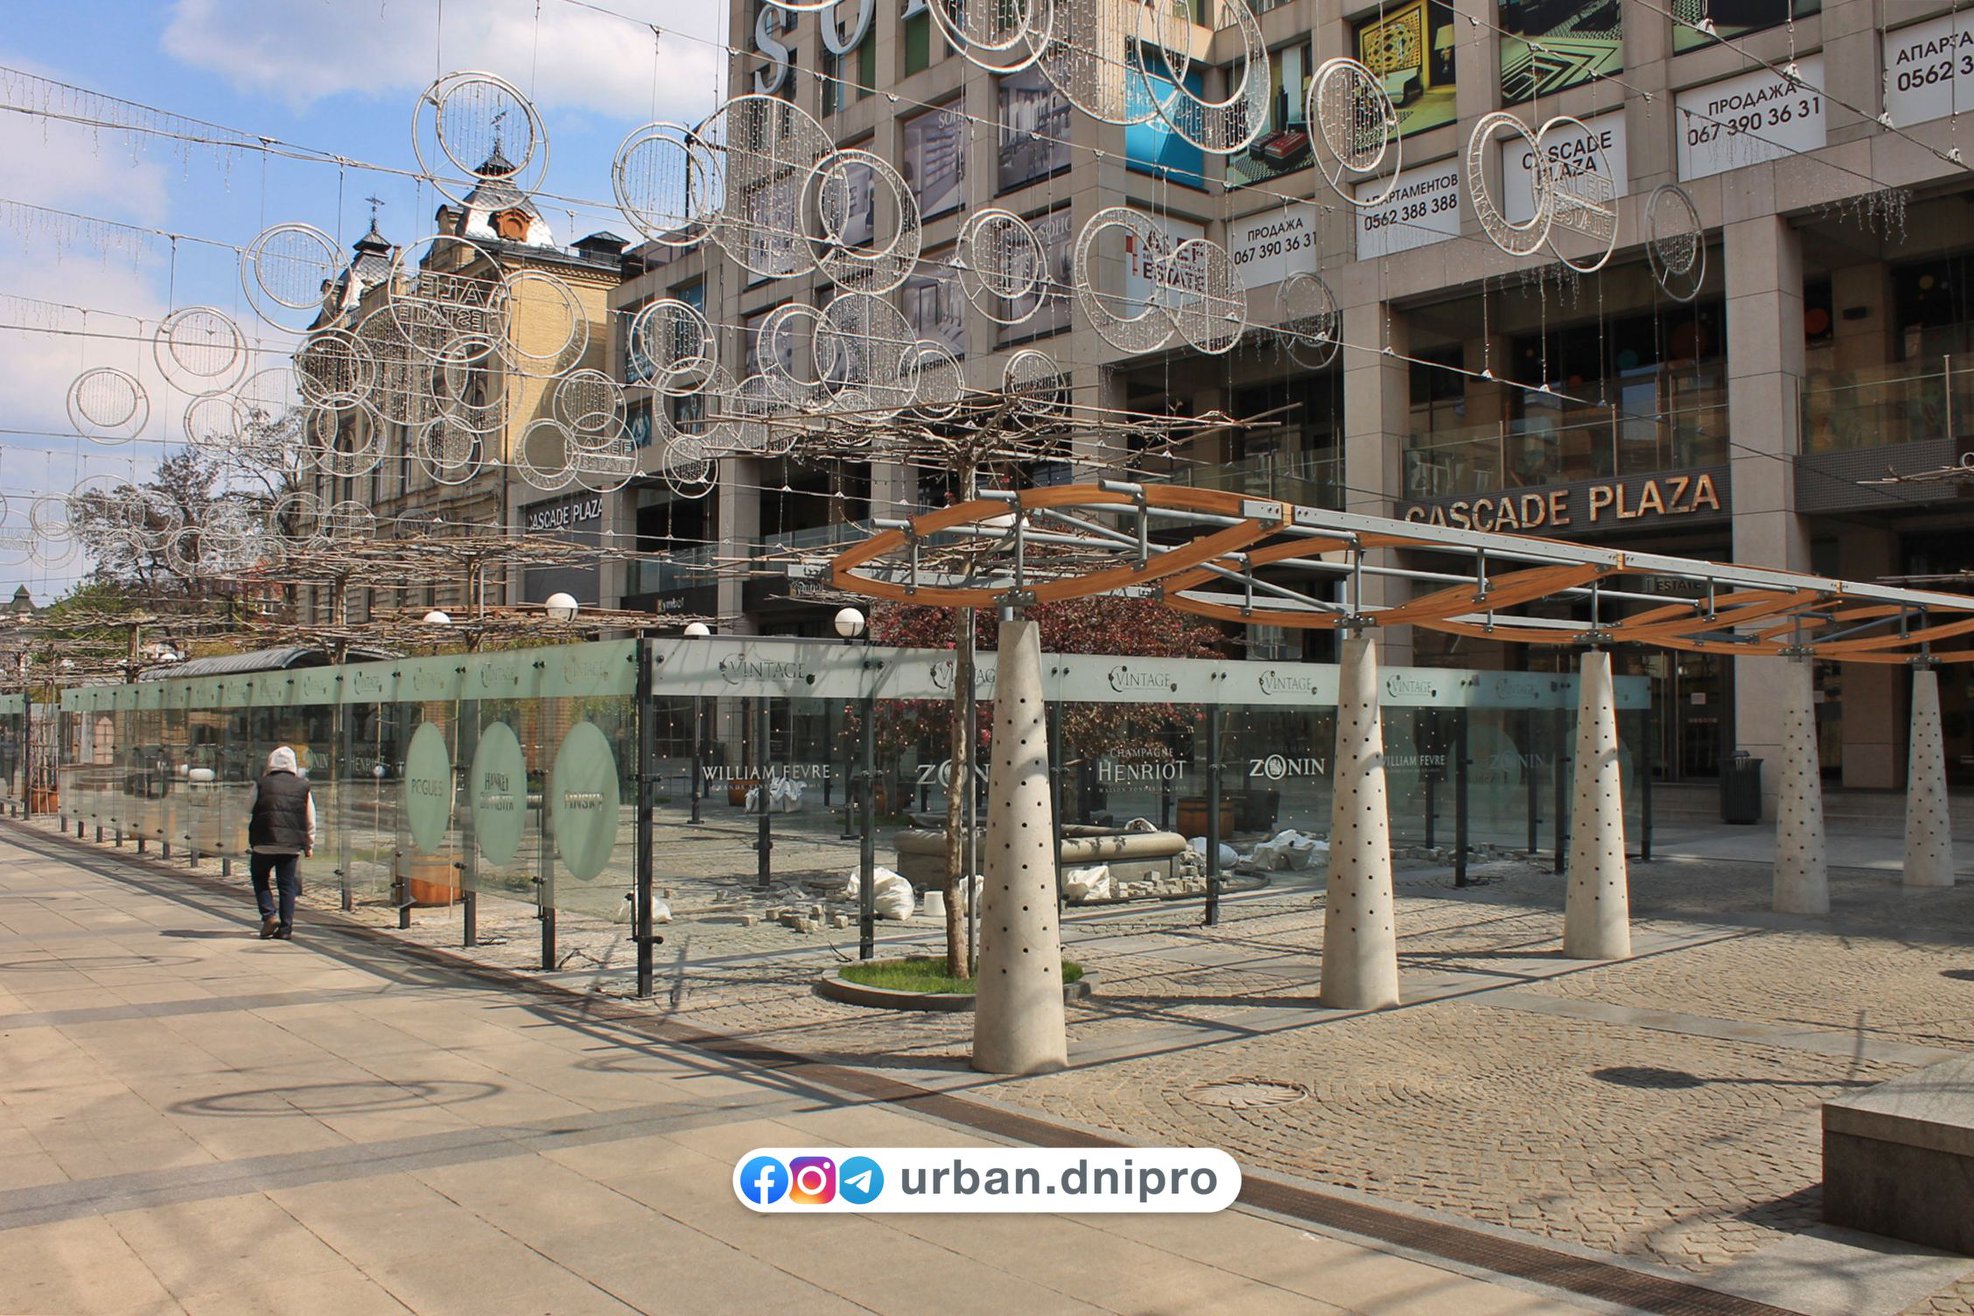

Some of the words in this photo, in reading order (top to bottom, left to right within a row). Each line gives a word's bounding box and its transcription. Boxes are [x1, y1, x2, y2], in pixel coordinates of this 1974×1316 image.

[1897, 61, 1954, 92] 0562
[1708, 82, 1797, 116] ПРОДАЖА
[1688, 123, 1721, 146] 067
[1727, 112, 1762, 137] 390
[1768, 104, 1792, 126] 36
[1797, 96, 1820, 118] 31
[1522, 131, 1613, 170] CSCADE
[1364, 209, 1397, 231] 0562
[1401, 202, 1427, 222] 388
[1431, 193, 1457, 214] 388
[1247, 217, 1304, 242] ПРОДАЖА
[1234, 248, 1256, 266] 067
[1259, 241, 1282, 259] 390
[1285, 235, 1300, 252] 36
[1303, 231, 1318, 248] 31
[1404, 489, 1571, 533] CASCADE
[1589, 474, 1721, 522] PLAZA
[730, 661, 806, 679] VINTAGE
[1116, 672, 1171, 687] VINTAGE
[1265, 676, 1312, 691] VINTAGE
[1391, 680, 1432, 693] VINTAGE
[1110, 748, 1174, 758] CHAMPAGNE
[1420, 754, 1446, 766] FEVRE
[702, 765, 776, 781] WILLIAM
[782, 764, 831, 780] FEVRE
[917, 758, 989, 788] ZON
[1098, 760, 1188, 783] HENRIOT
[1249, 754, 1325, 780] ZONIN
